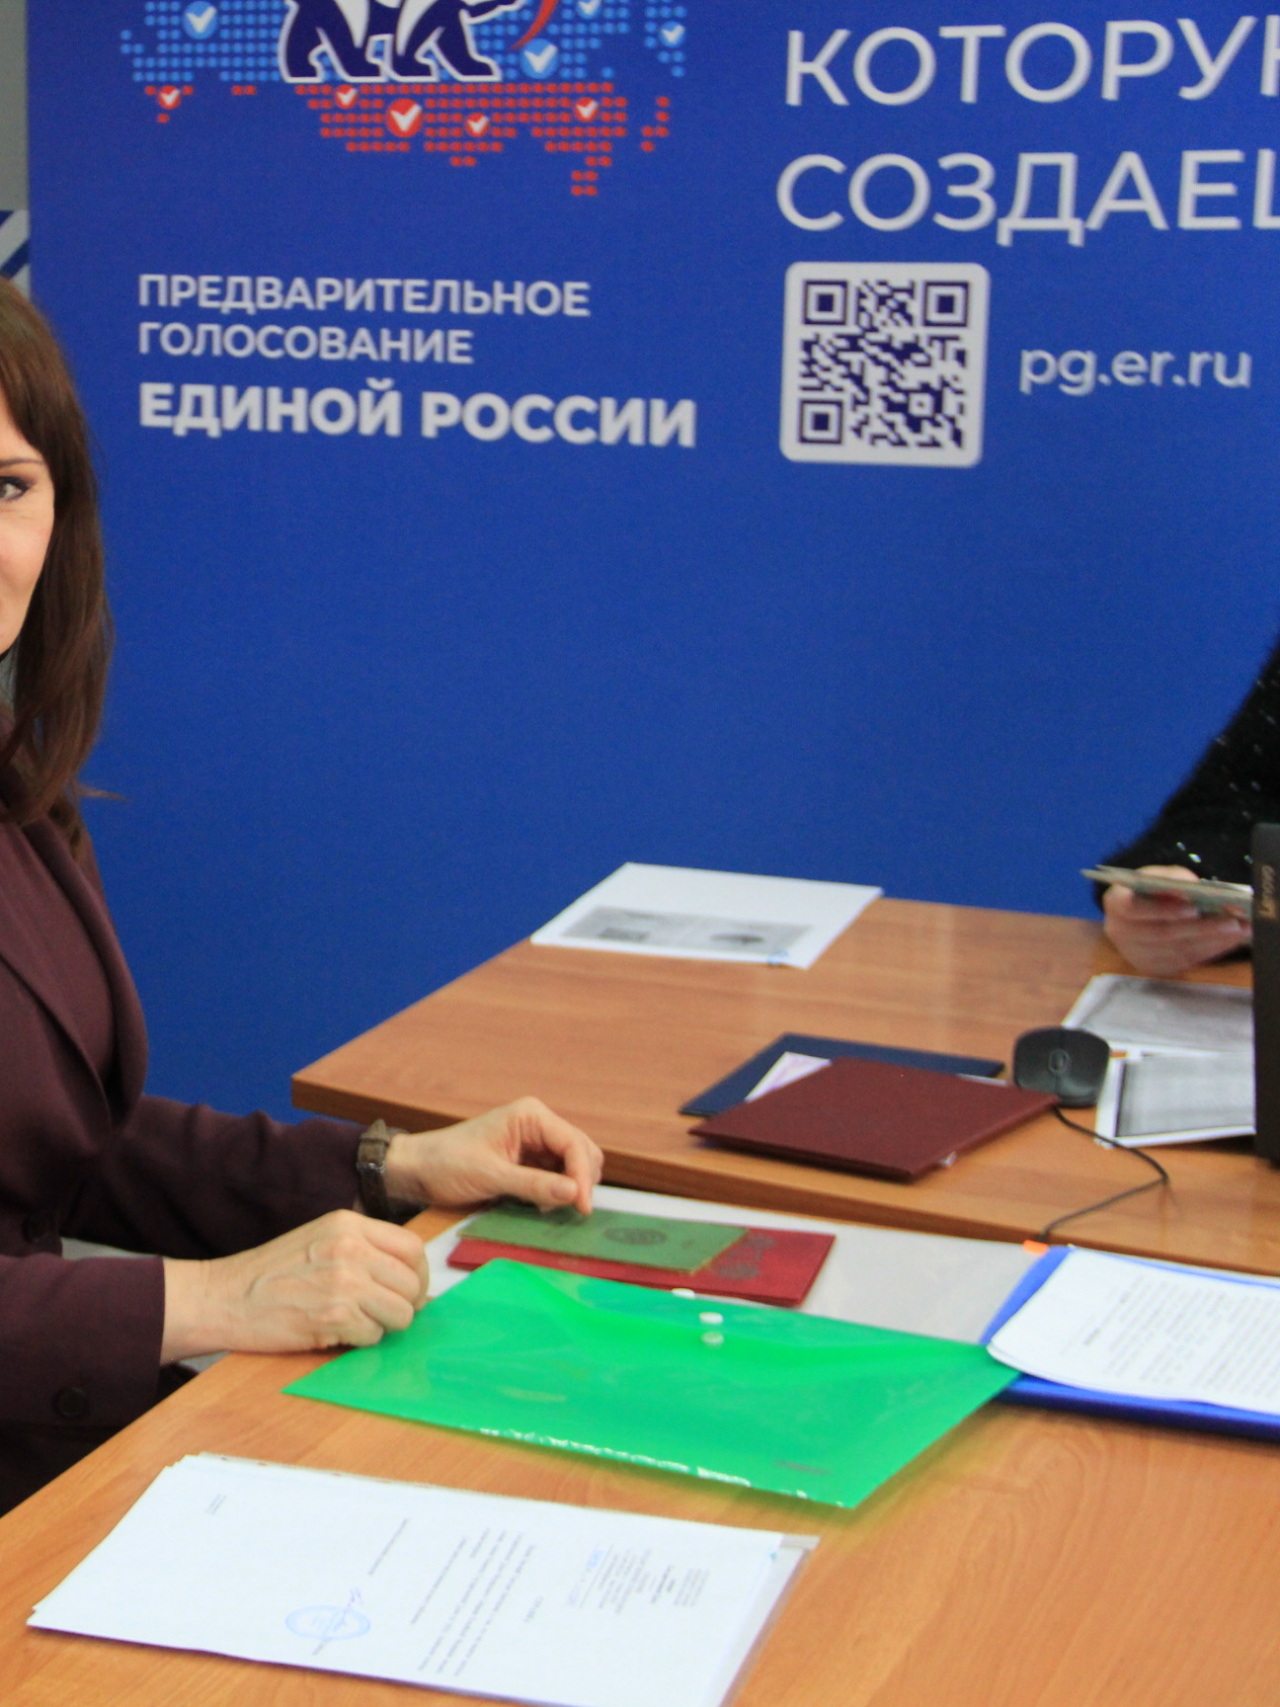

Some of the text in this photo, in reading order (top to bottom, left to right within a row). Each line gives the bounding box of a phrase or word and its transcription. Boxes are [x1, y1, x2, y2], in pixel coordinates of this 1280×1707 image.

[138, 274, 591, 317] ПРЕДВАРИТЕЛЬНОЕ
[138, 322, 474, 364] ГОЛОСОВАНИЕ
[1019, 349, 1253, 396] pg.er.ru
[139, 377, 696, 448] ЕДИНОЙ РОССИИ
